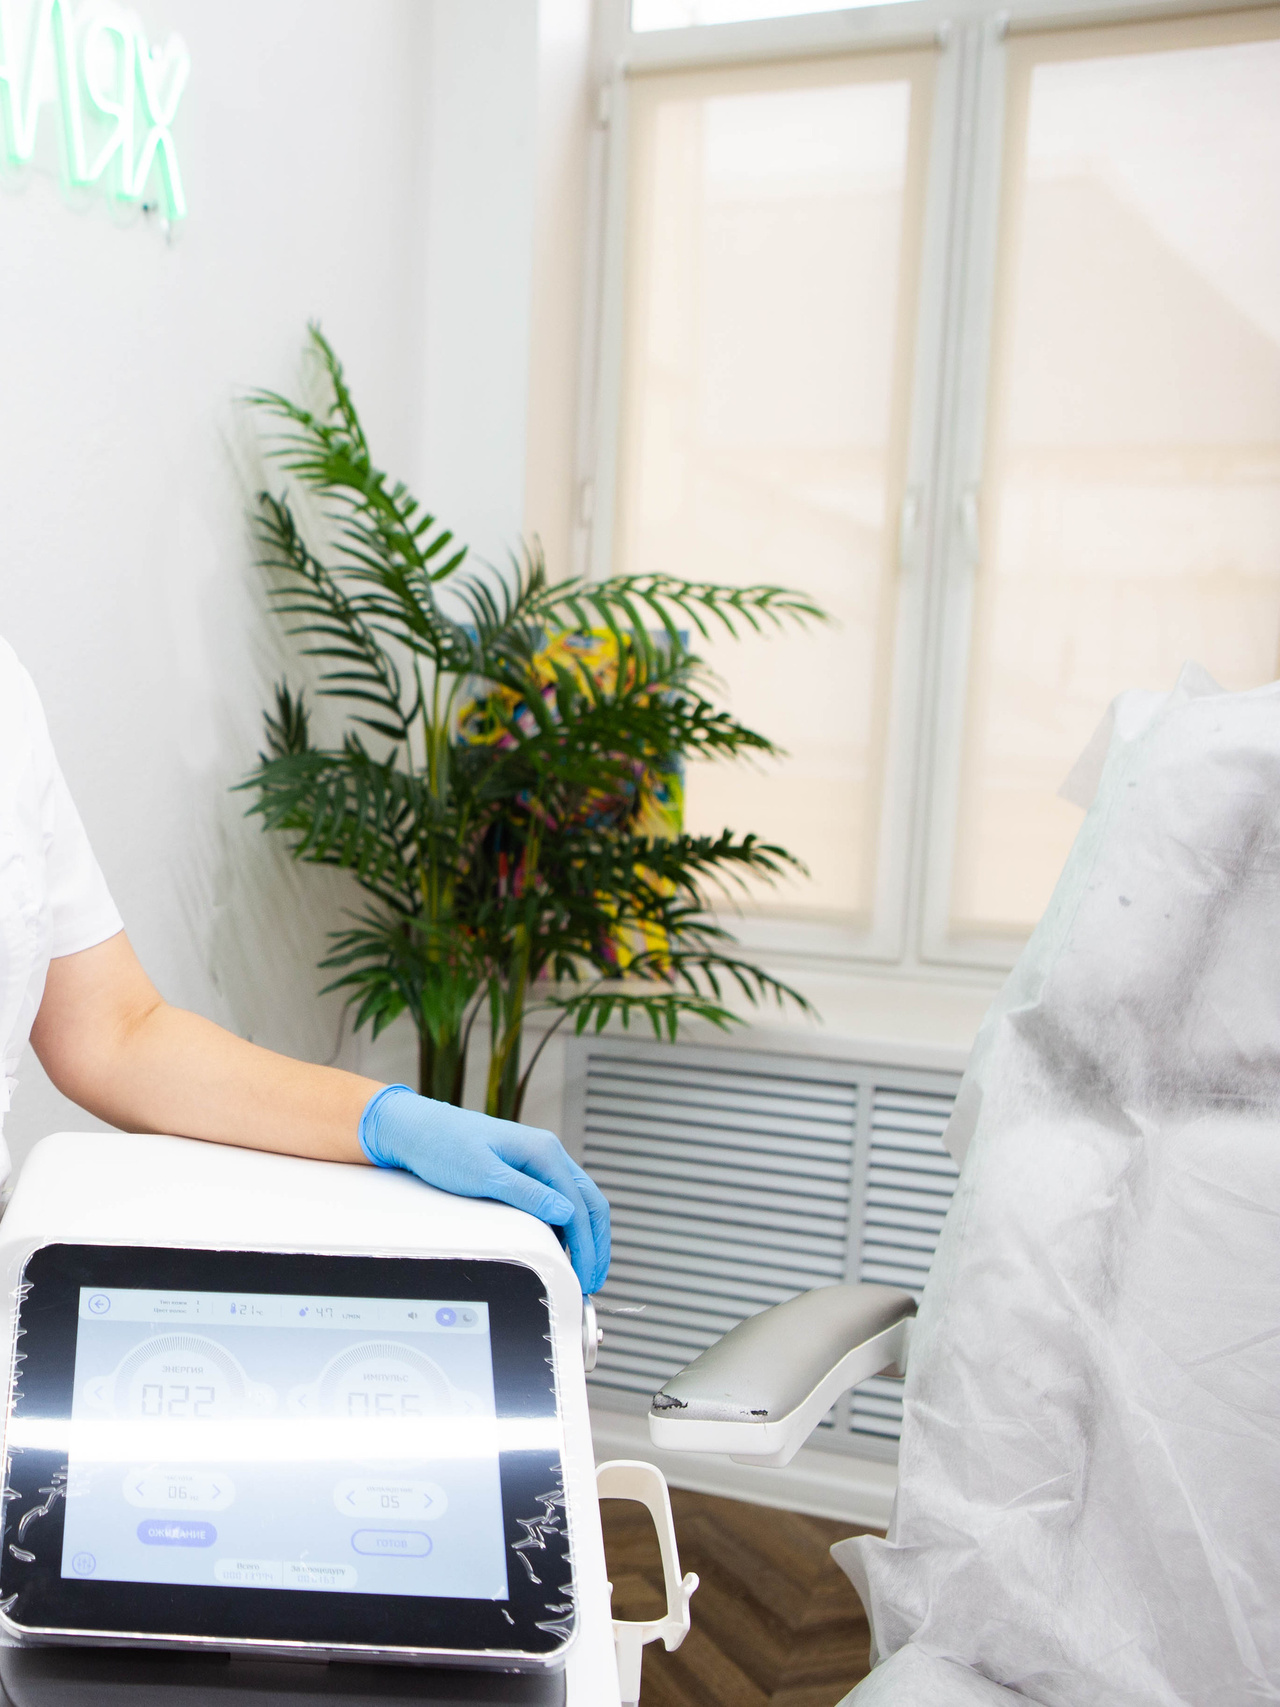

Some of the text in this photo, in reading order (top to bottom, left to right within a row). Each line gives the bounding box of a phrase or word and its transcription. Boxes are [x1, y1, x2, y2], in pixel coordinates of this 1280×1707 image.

[161, 1365, 204, 1375] ЭНЕРГИЯ
[363, 1373, 409, 1383] ИМПУЛЬС
[141, 1384, 215, 1417] 022
[168, 1486, 187, 1499] 06
[381, 1495, 400, 1508] 05
[148, 1528, 206, 1540] ОЖИДАНИЕ
